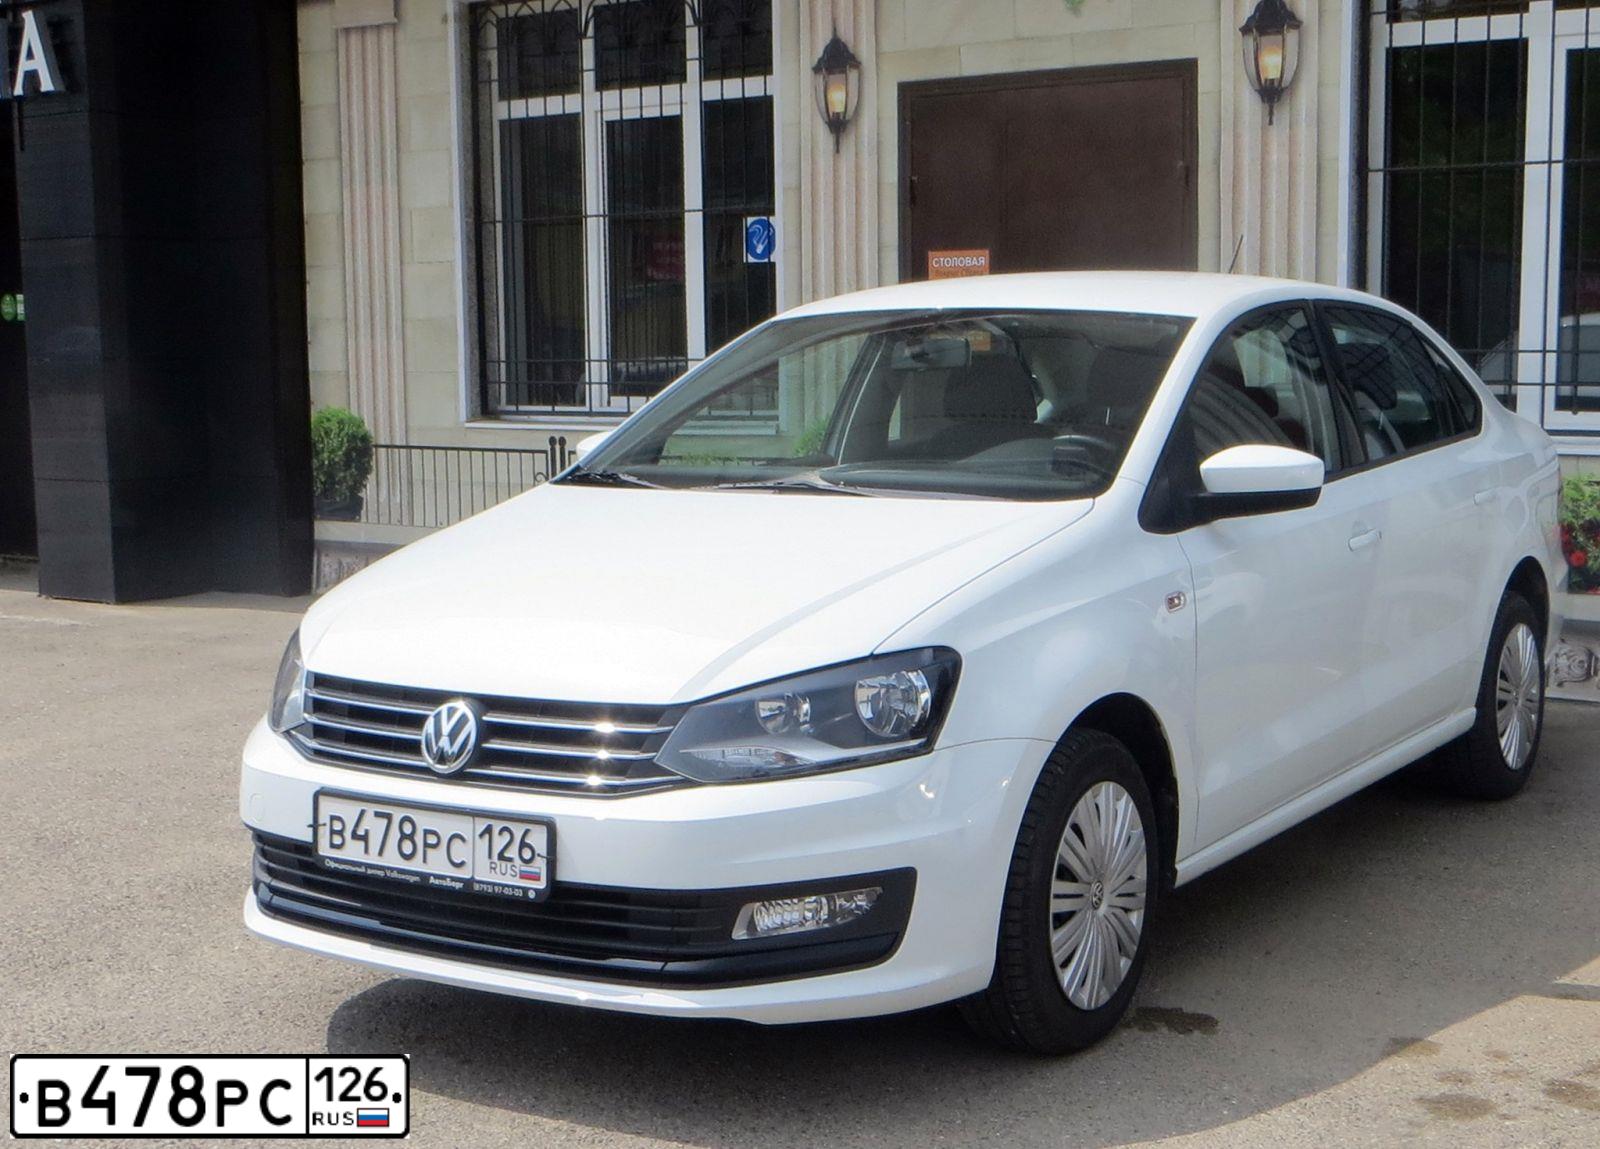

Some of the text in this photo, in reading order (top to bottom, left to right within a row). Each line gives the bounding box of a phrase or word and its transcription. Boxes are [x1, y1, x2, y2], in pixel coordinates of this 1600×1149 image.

[932, 256, 986, 267] СТОЛОВАЯ
[329, 808, 537, 869] В478РС 126
[489, 861, 518, 878] RUS
